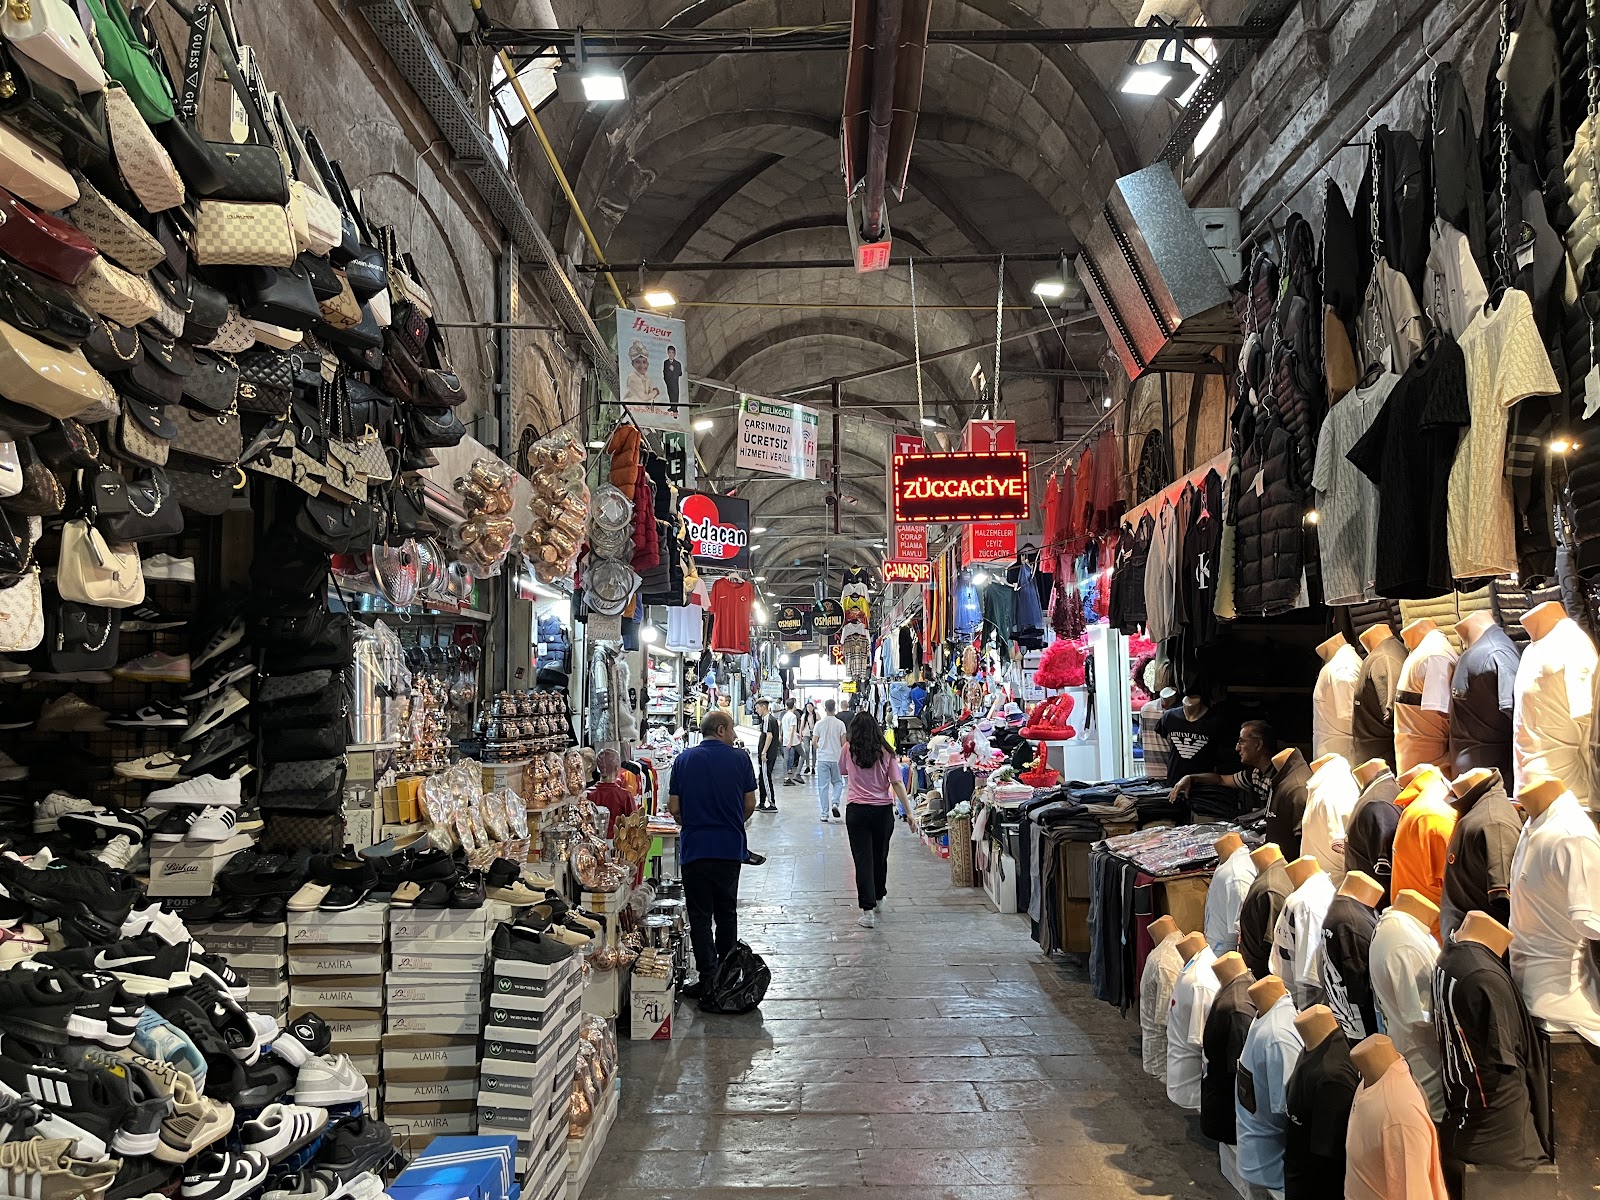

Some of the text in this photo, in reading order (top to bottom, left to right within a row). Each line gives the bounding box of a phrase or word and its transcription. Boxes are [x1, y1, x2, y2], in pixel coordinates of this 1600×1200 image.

[188, 34, 203, 69] GUESS
[632, 316, 672, 337] HARPUT
[761, 405, 791, 417] MELİKGAZİ
[744, 419, 791, 435] ÇARŞIMIZDA
[744, 431, 788, 450] ÜCRETSİZ
[740, 446, 768, 460] HİZMETİ
[903, 475, 1022, 499] ZÜCCACİYE
[897, 525, 925, 534] ÇAMAŞIR
[900, 533, 923, 541] ÇORAP
[701, 543, 723, 555] BEBE
[900, 541, 924, 549] PİJAMA
[985, 539, 1003, 548] ÇEYİZ
[884, 563, 930, 581] ÇAMAŞIR
[778, 619, 801, 628] OSMANLI
[814, 616, 842, 626] OSMANLI
[1191, 733, 1209, 741] JEANS
[316, 960, 353, 969] ALMİRA
[318, 991, 353, 1001] ALMİRA
[329, 1022, 353, 1033] MİRA
[412, 1051, 448, 1061] ALMİRA
[414, 1084, 450, 1095] ALMİRA
[413, 1117, 449, 1128] ALMİRA
[184, 1174, 201, 1182] NIKE
